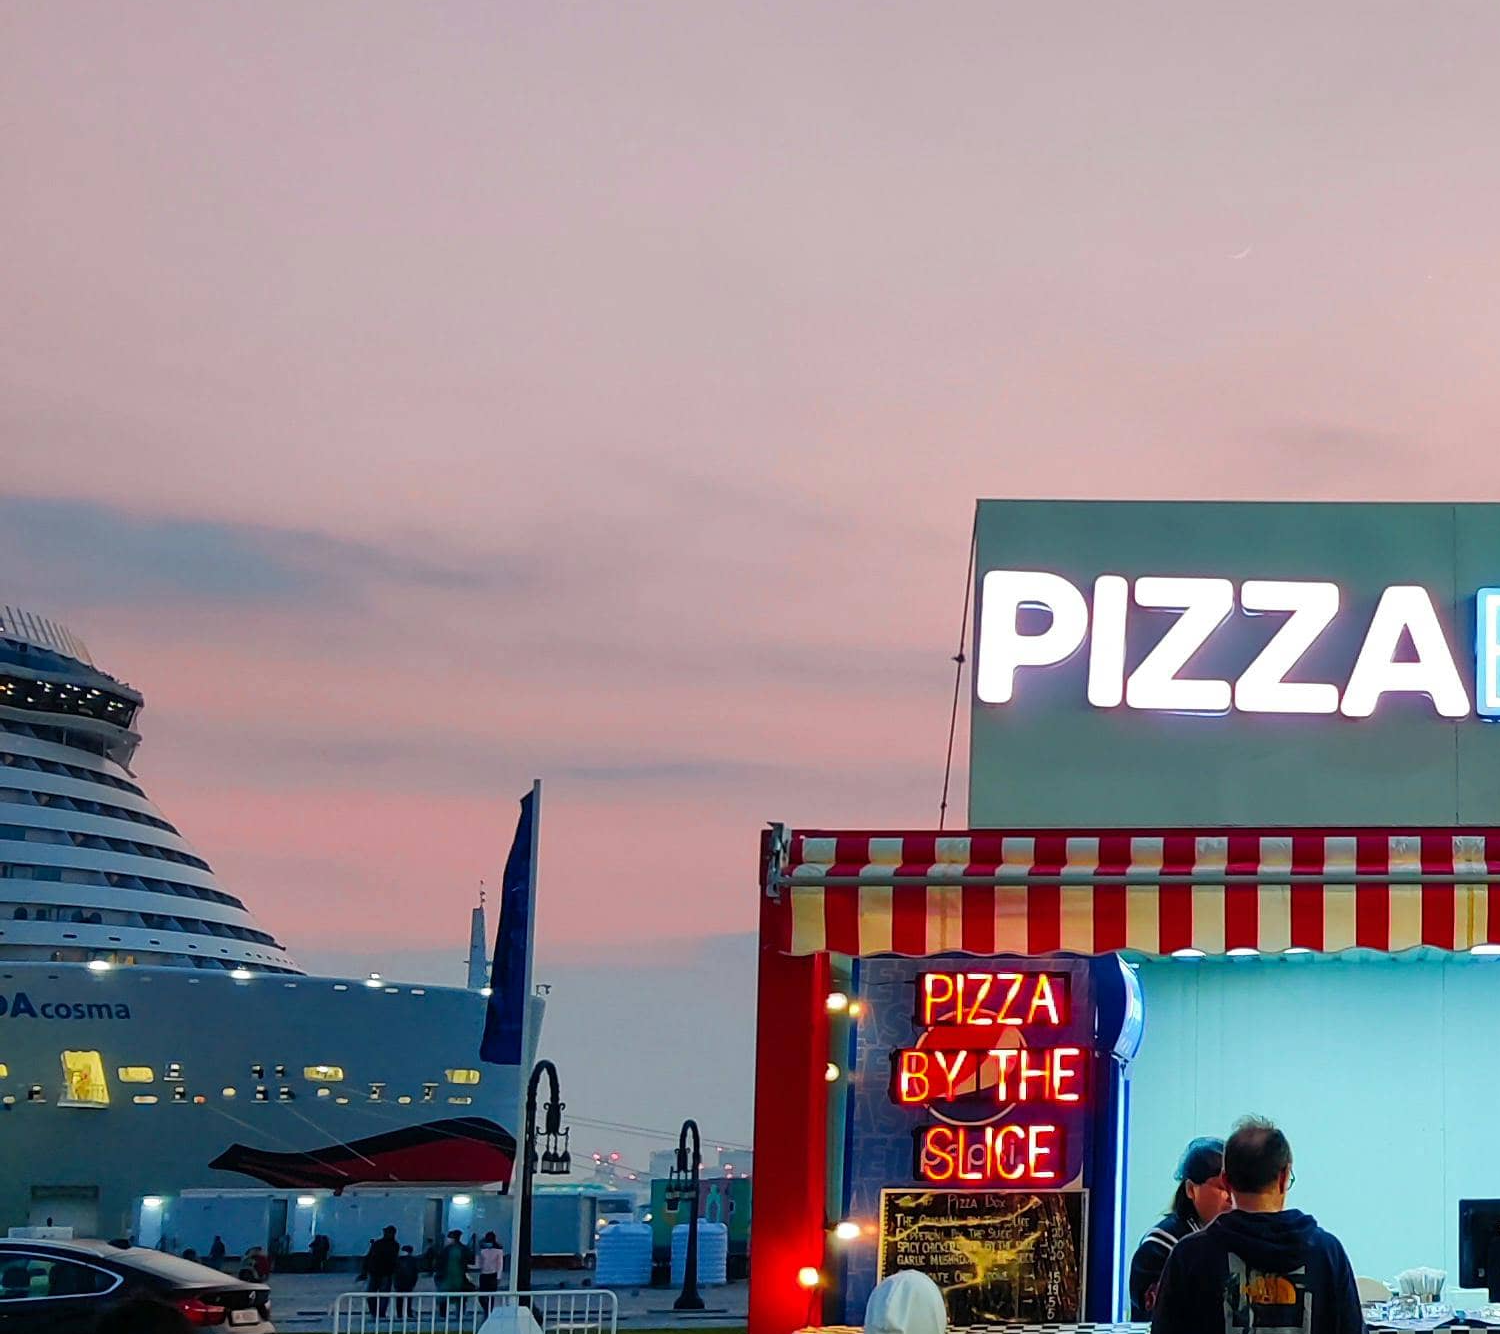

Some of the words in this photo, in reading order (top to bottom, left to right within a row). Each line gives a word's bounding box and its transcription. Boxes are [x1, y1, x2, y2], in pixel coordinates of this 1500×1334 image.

[925, 973, 1059, 1025] PIZZA
[901, 1050, 967, 1102] BY
[988, 1048, 1080, 1101] THE
[925, 1125, 1056, 1180] SLICE
